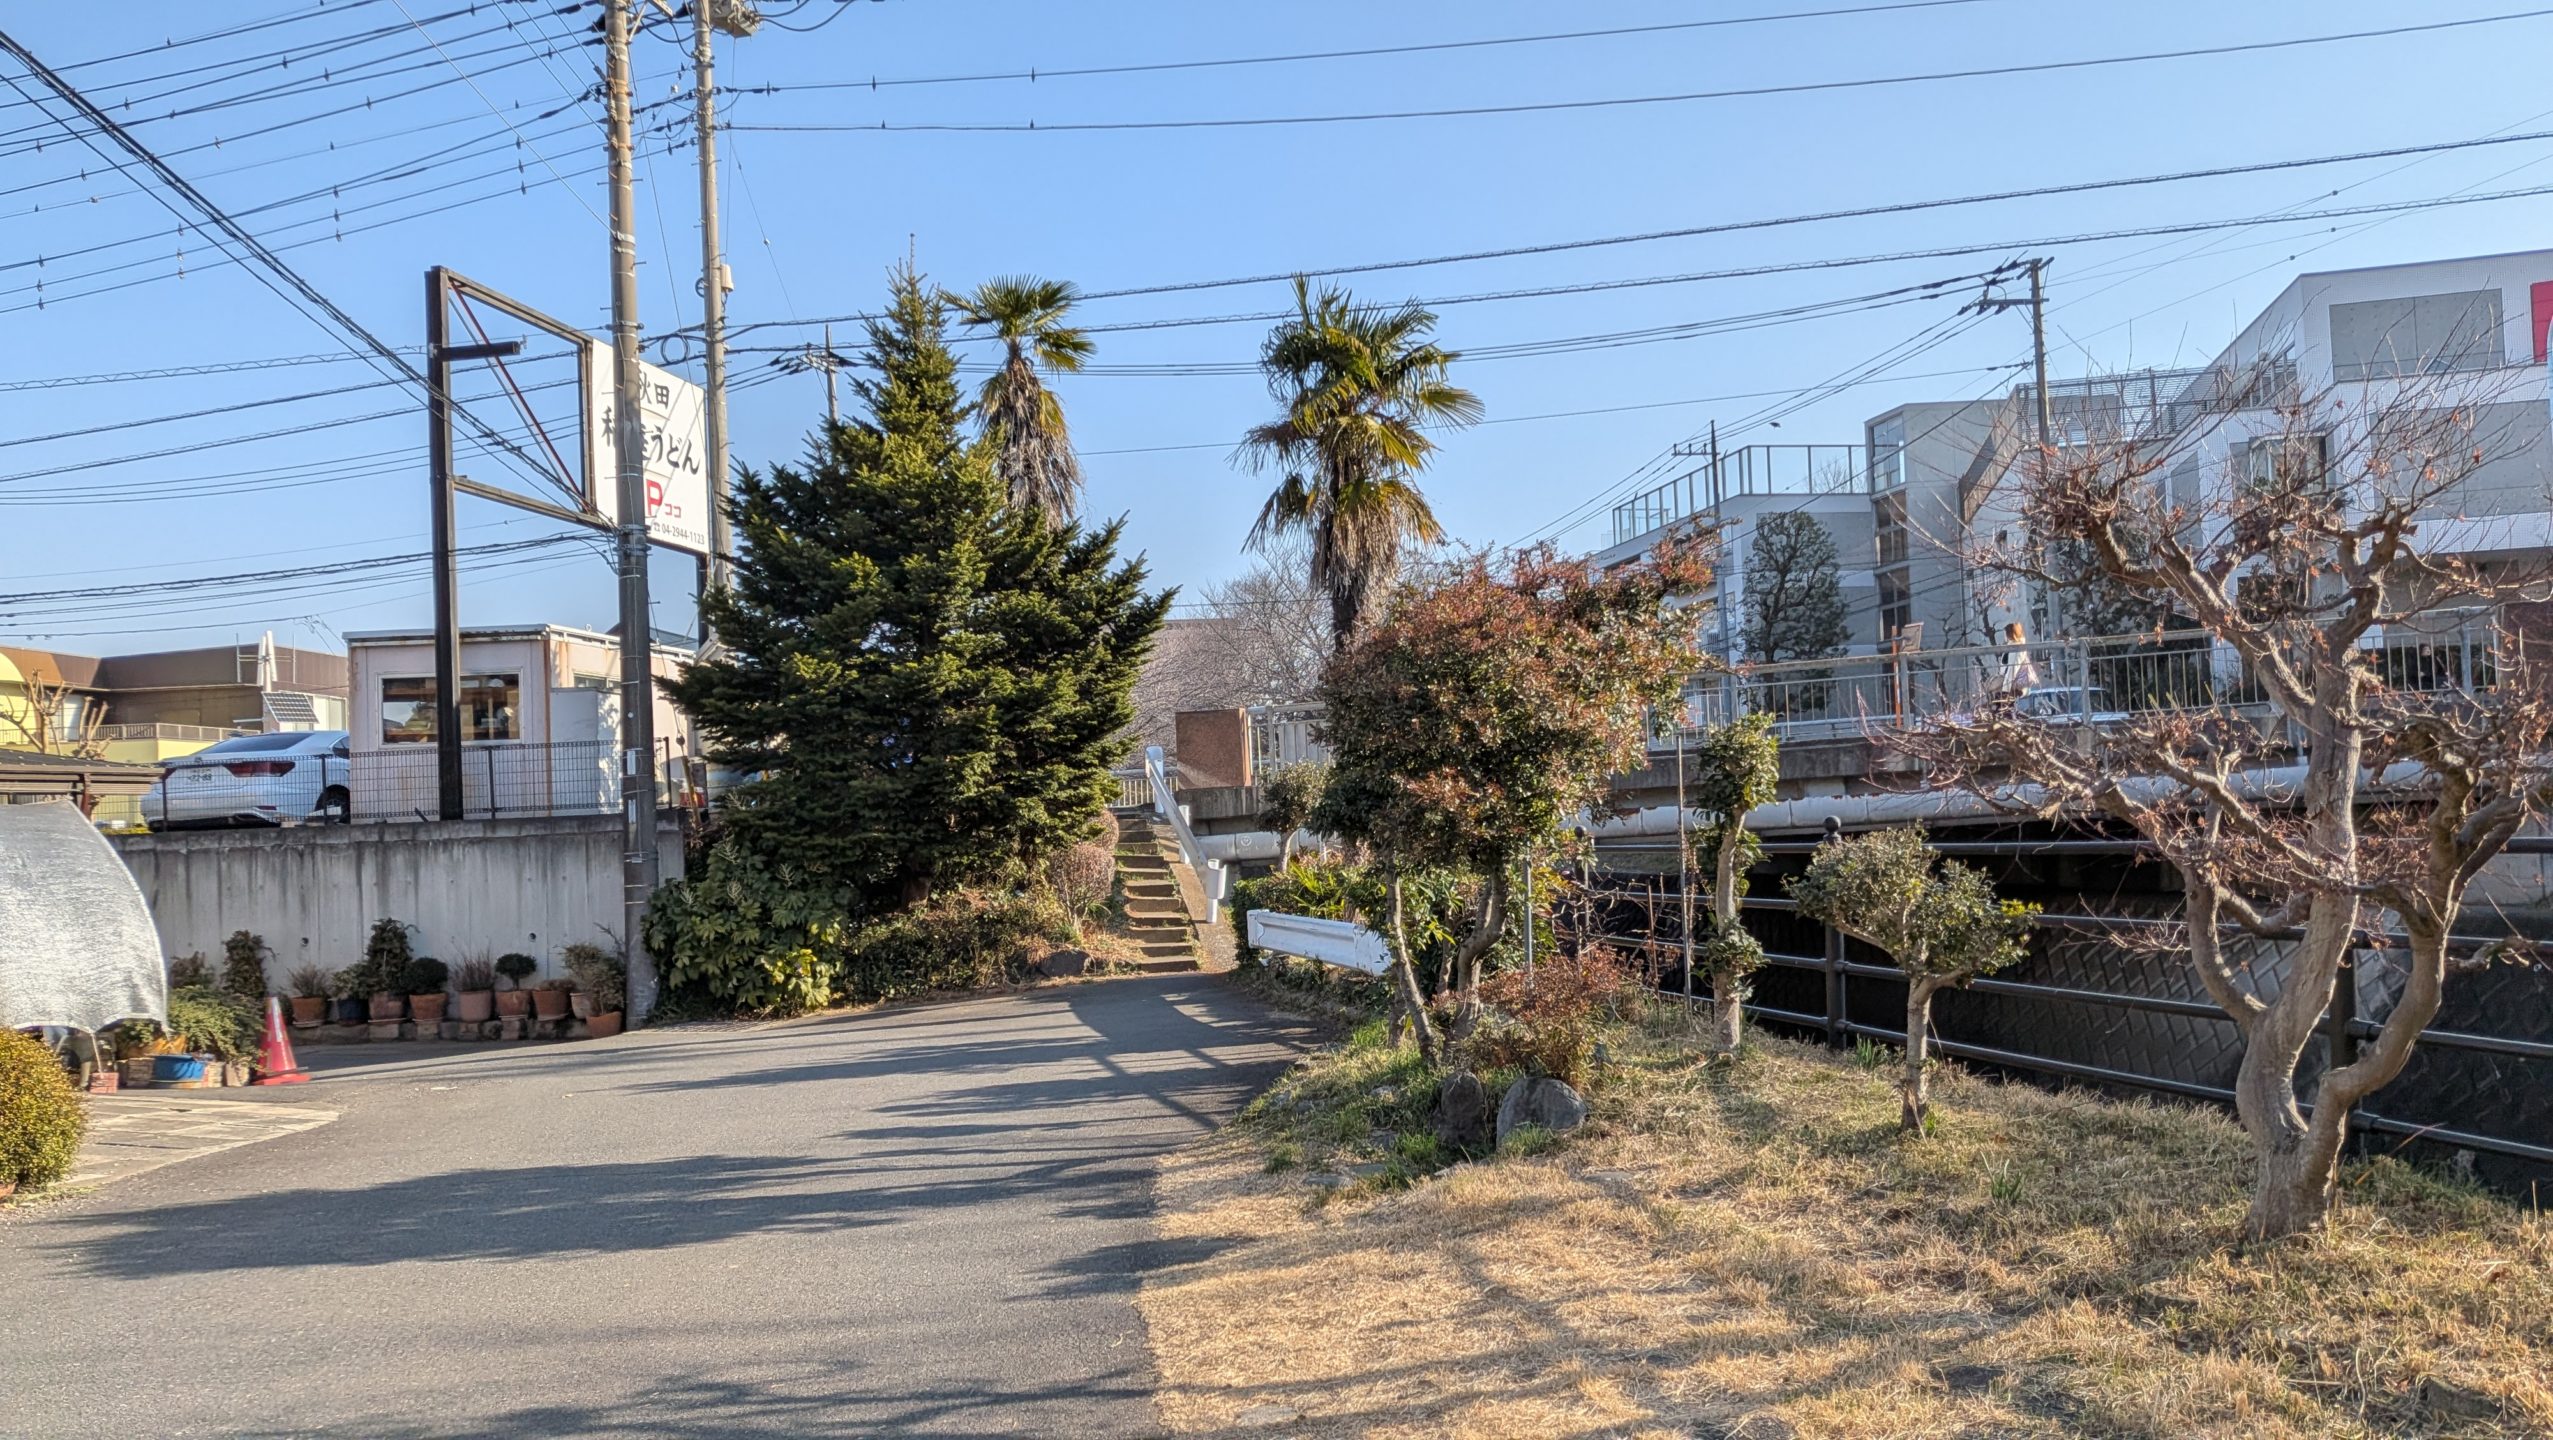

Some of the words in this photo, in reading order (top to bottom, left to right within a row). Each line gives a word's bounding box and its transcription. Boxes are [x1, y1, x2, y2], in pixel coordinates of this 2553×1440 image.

[646, 478, 664, 517] P
[664, 502, 682, 519] ココ
[661, 523, 706, 546] 04-2944-1123
